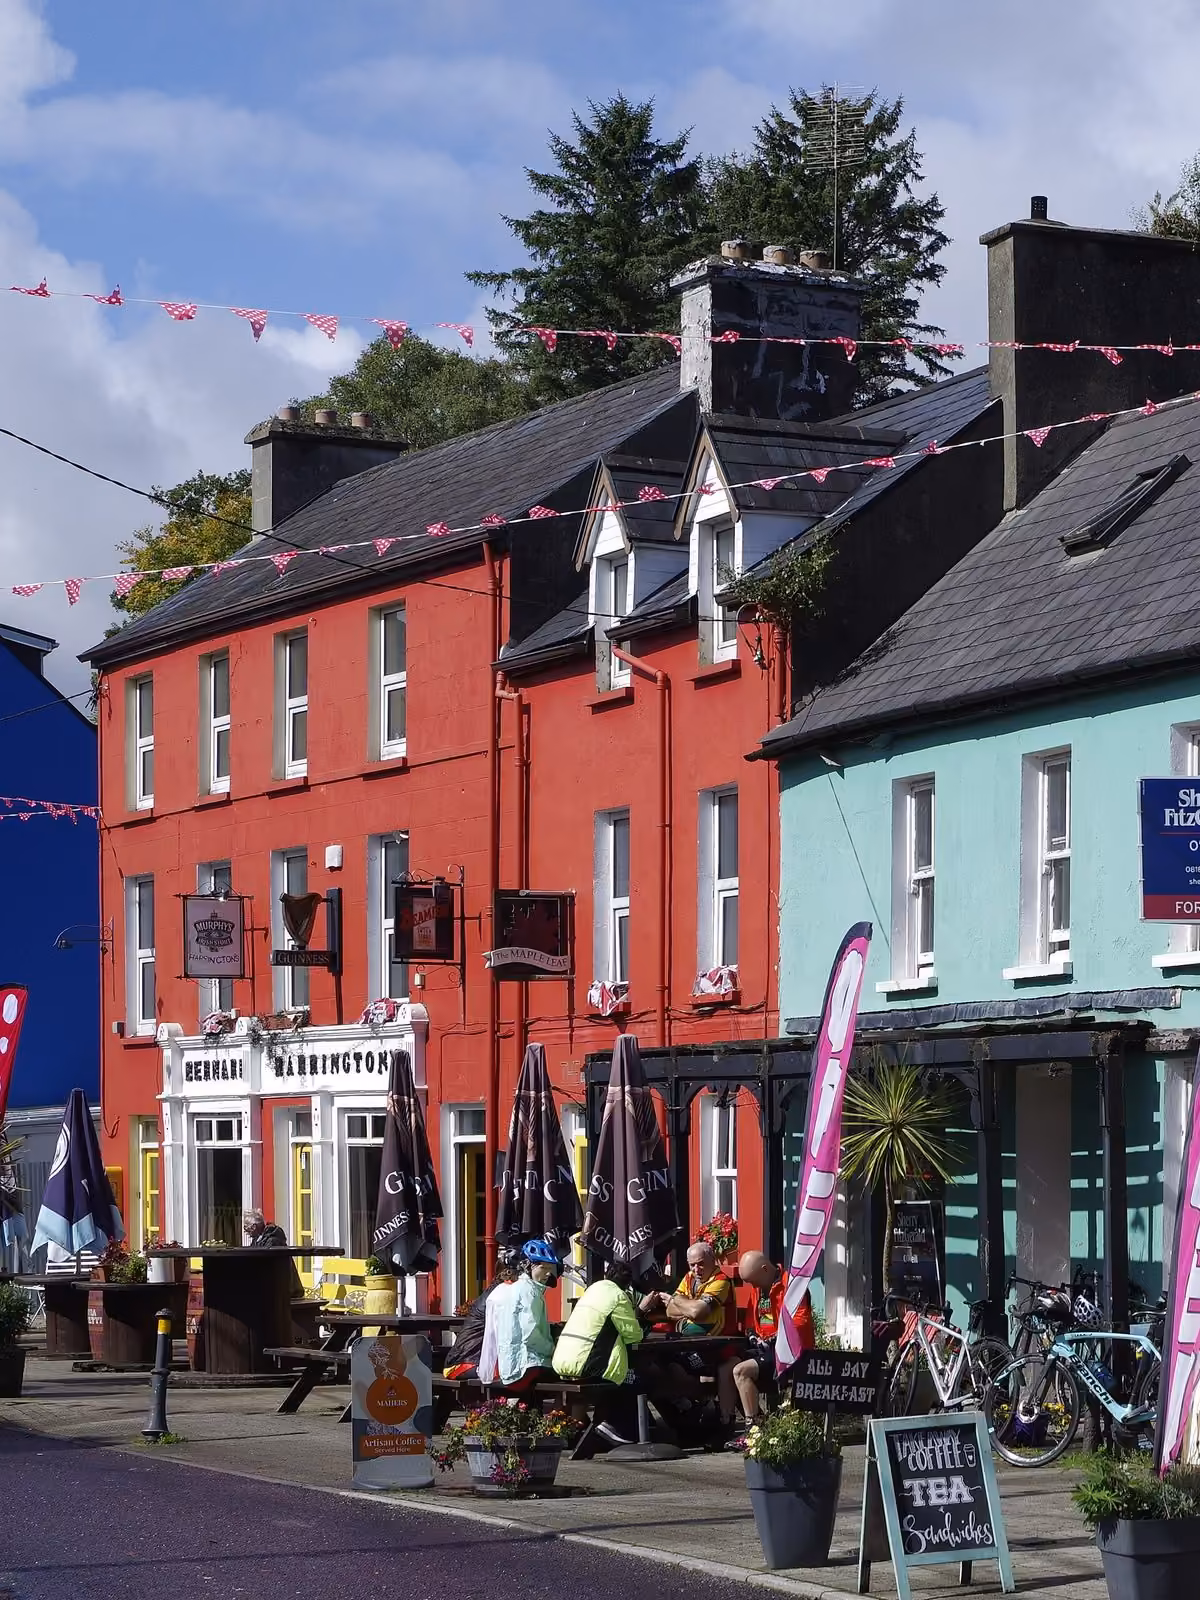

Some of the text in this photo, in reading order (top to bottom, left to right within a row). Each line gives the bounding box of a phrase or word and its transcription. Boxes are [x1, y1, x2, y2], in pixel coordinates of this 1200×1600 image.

[278, 953, 330, 964] GUINNESS
[510, 949, 545, 963] MAPLE
[546, 956, 568, 967] LEAF
[807, 1358, 870, 1379] ALL DAY
[1069, 1354, 1113, 1406] Bianchi
[795, 1383, 876, 1404] BREAKFAST
[364, 1436, 422, 1447] Artisan Coffee
[908, 1443, 965, 1472] COFFEE
[901, 1474, 975, 1507] TEA
[902, 1510, 994, 1555] Sandwiches
